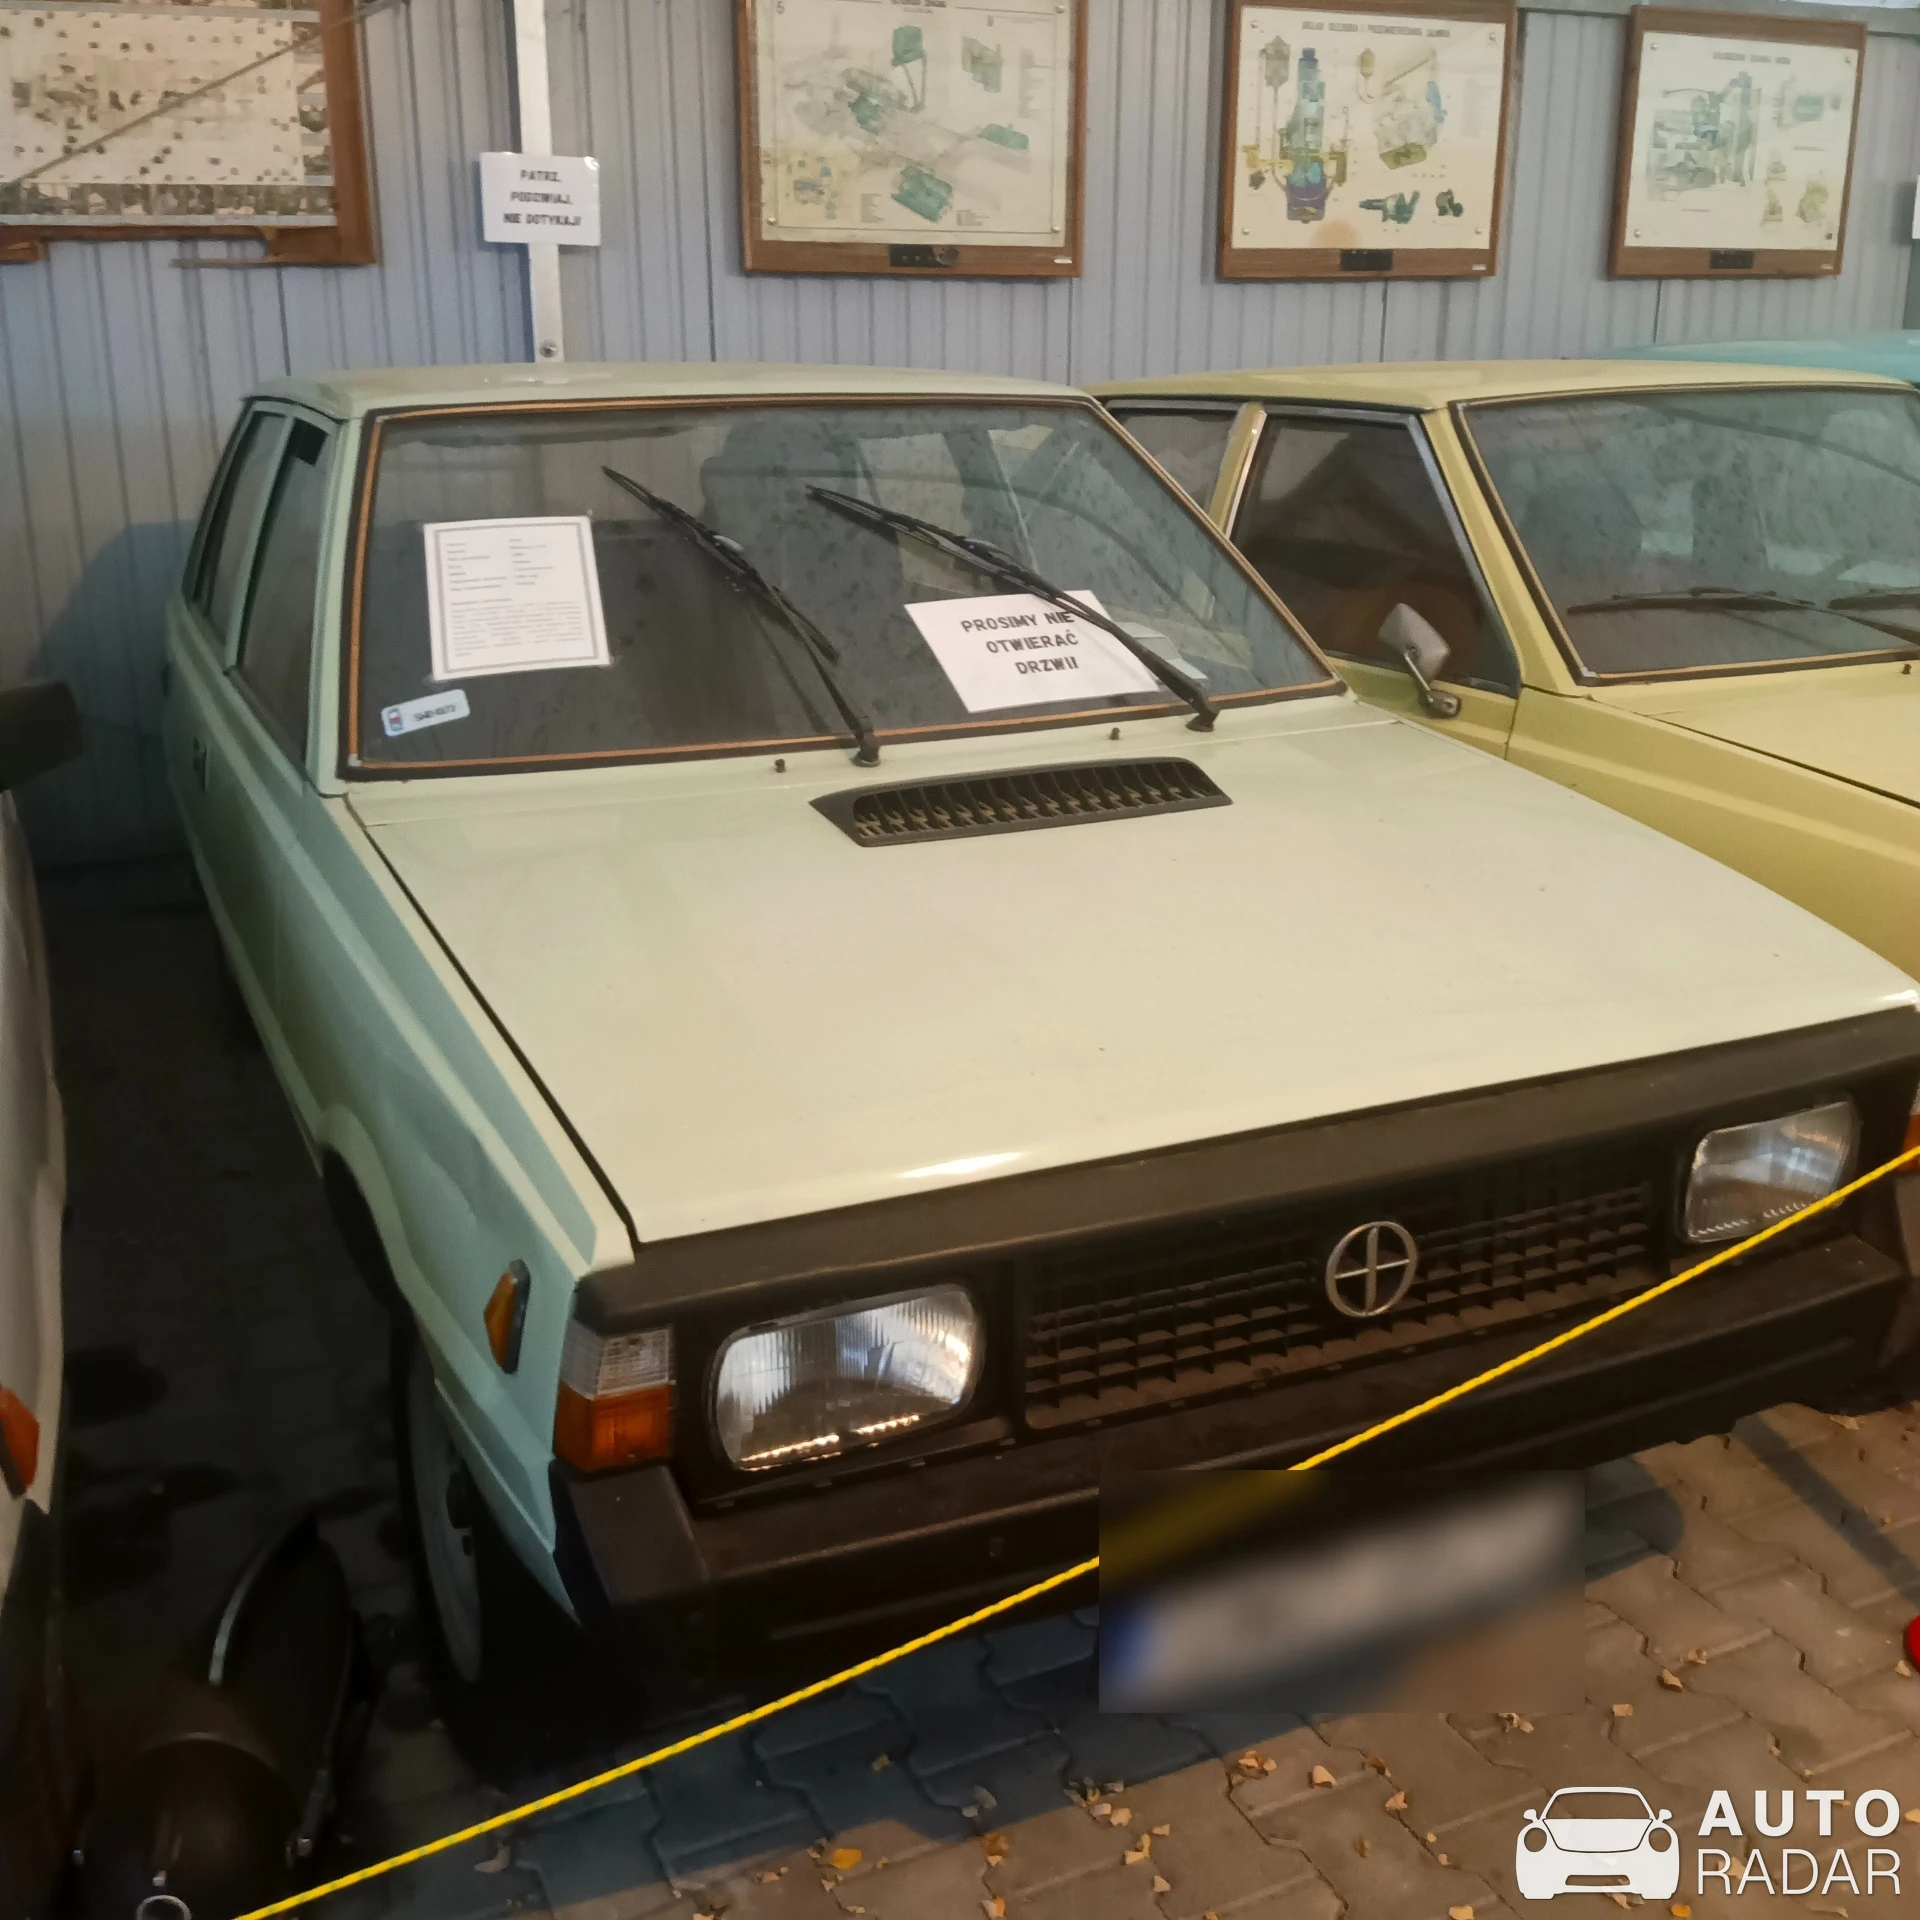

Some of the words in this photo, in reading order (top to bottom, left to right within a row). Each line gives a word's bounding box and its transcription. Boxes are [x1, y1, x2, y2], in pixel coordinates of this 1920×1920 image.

[503, 213, 522, 224] NIE
[961, 614, 1038, 632] PROSIMY
[1043, 611, 1075, 625] NIE
[986, 629, 1079, 654] OTWIERAĆ
